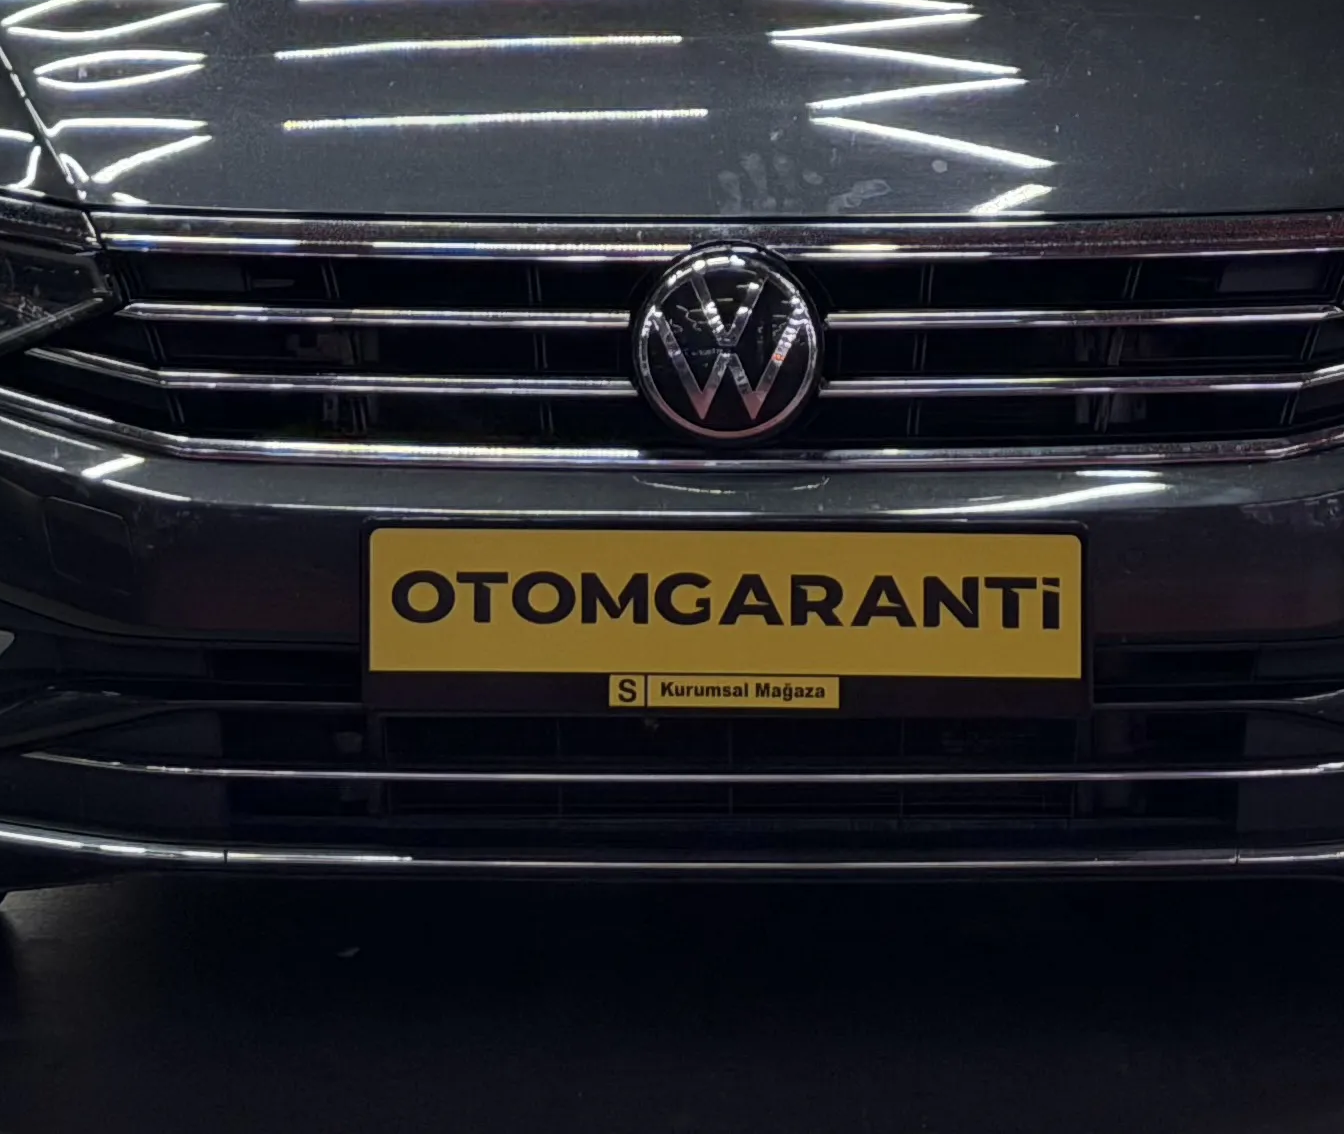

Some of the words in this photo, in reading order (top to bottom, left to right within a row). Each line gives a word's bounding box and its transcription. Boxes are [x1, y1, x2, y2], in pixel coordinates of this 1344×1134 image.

[618, 678, 637, 703] S
[660, 681, 749, 698] Kurumsal
[755, 683, 826, 702] Mağaza
